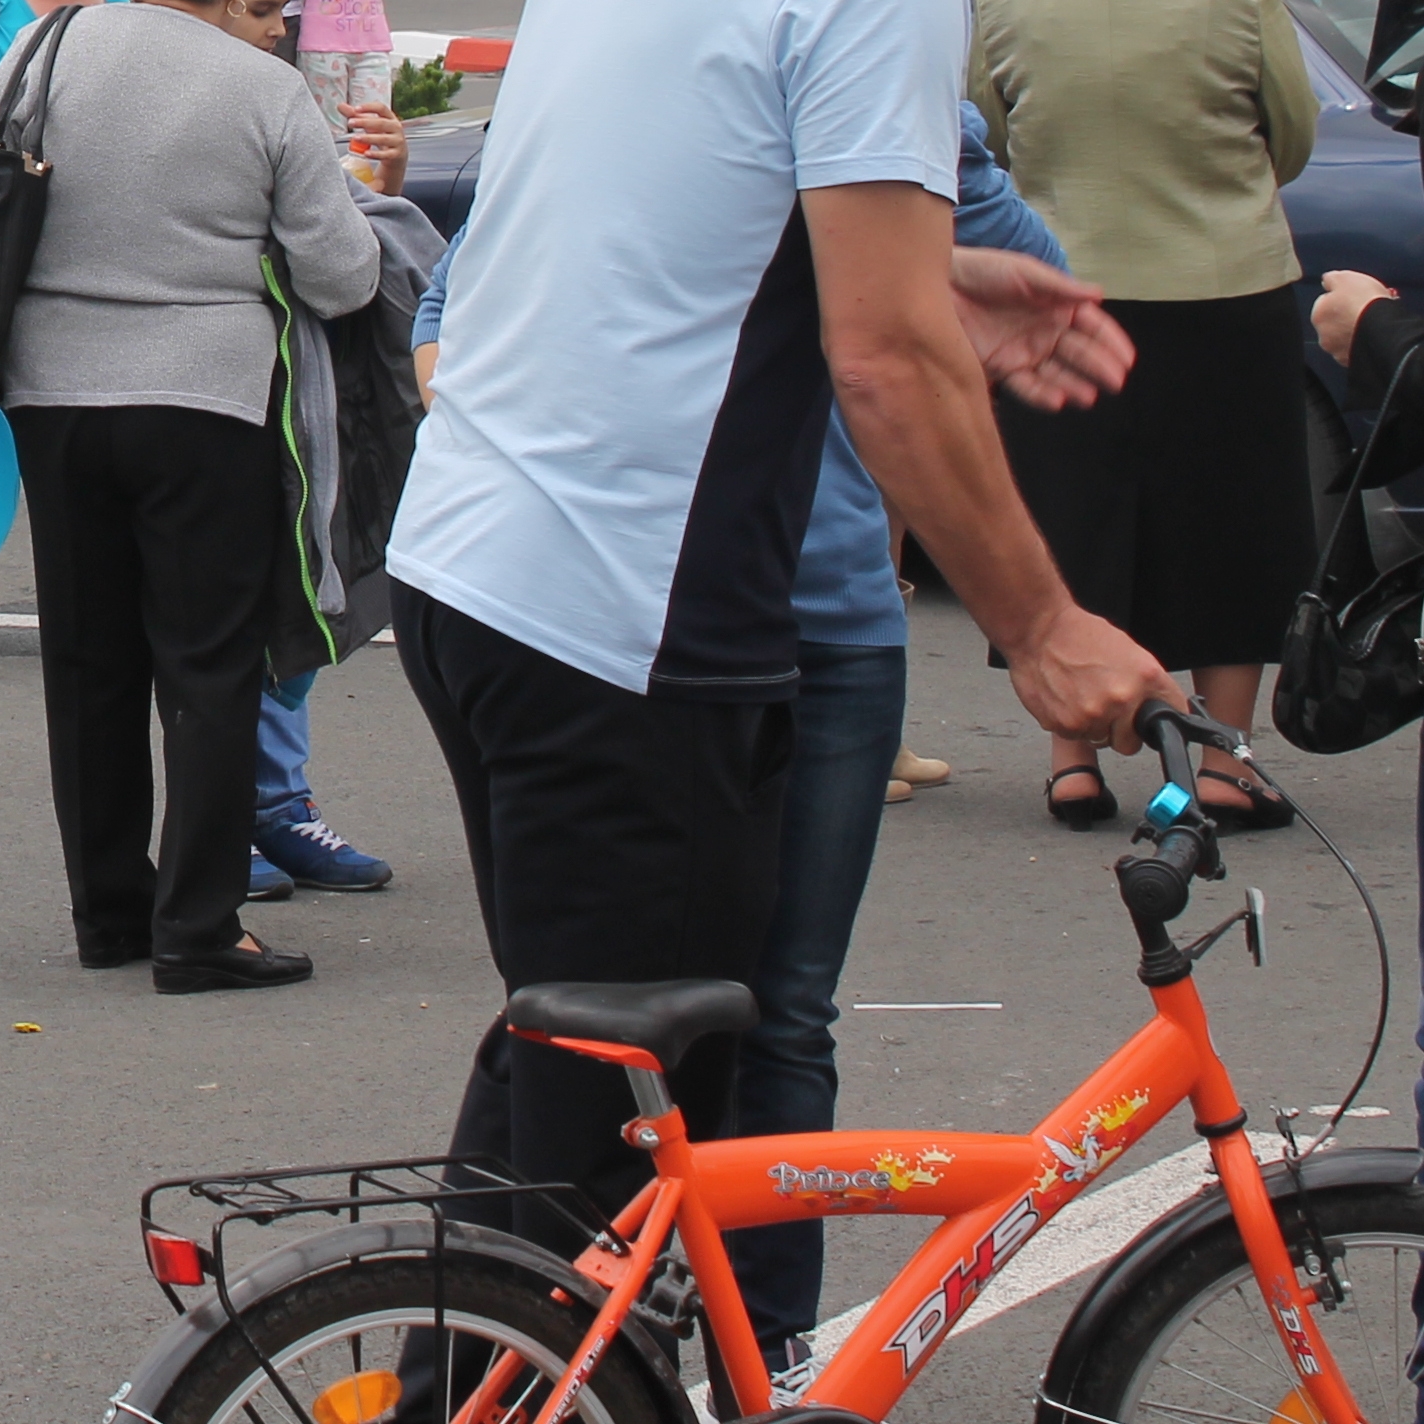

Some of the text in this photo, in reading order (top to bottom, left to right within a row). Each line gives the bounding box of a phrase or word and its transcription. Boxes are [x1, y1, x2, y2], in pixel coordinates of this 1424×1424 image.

[768, 1162, 892, 1194] Prince
[883, 1190, 1041, 1378] DHS
[1278, 1308, 1322, 1376] DHS
